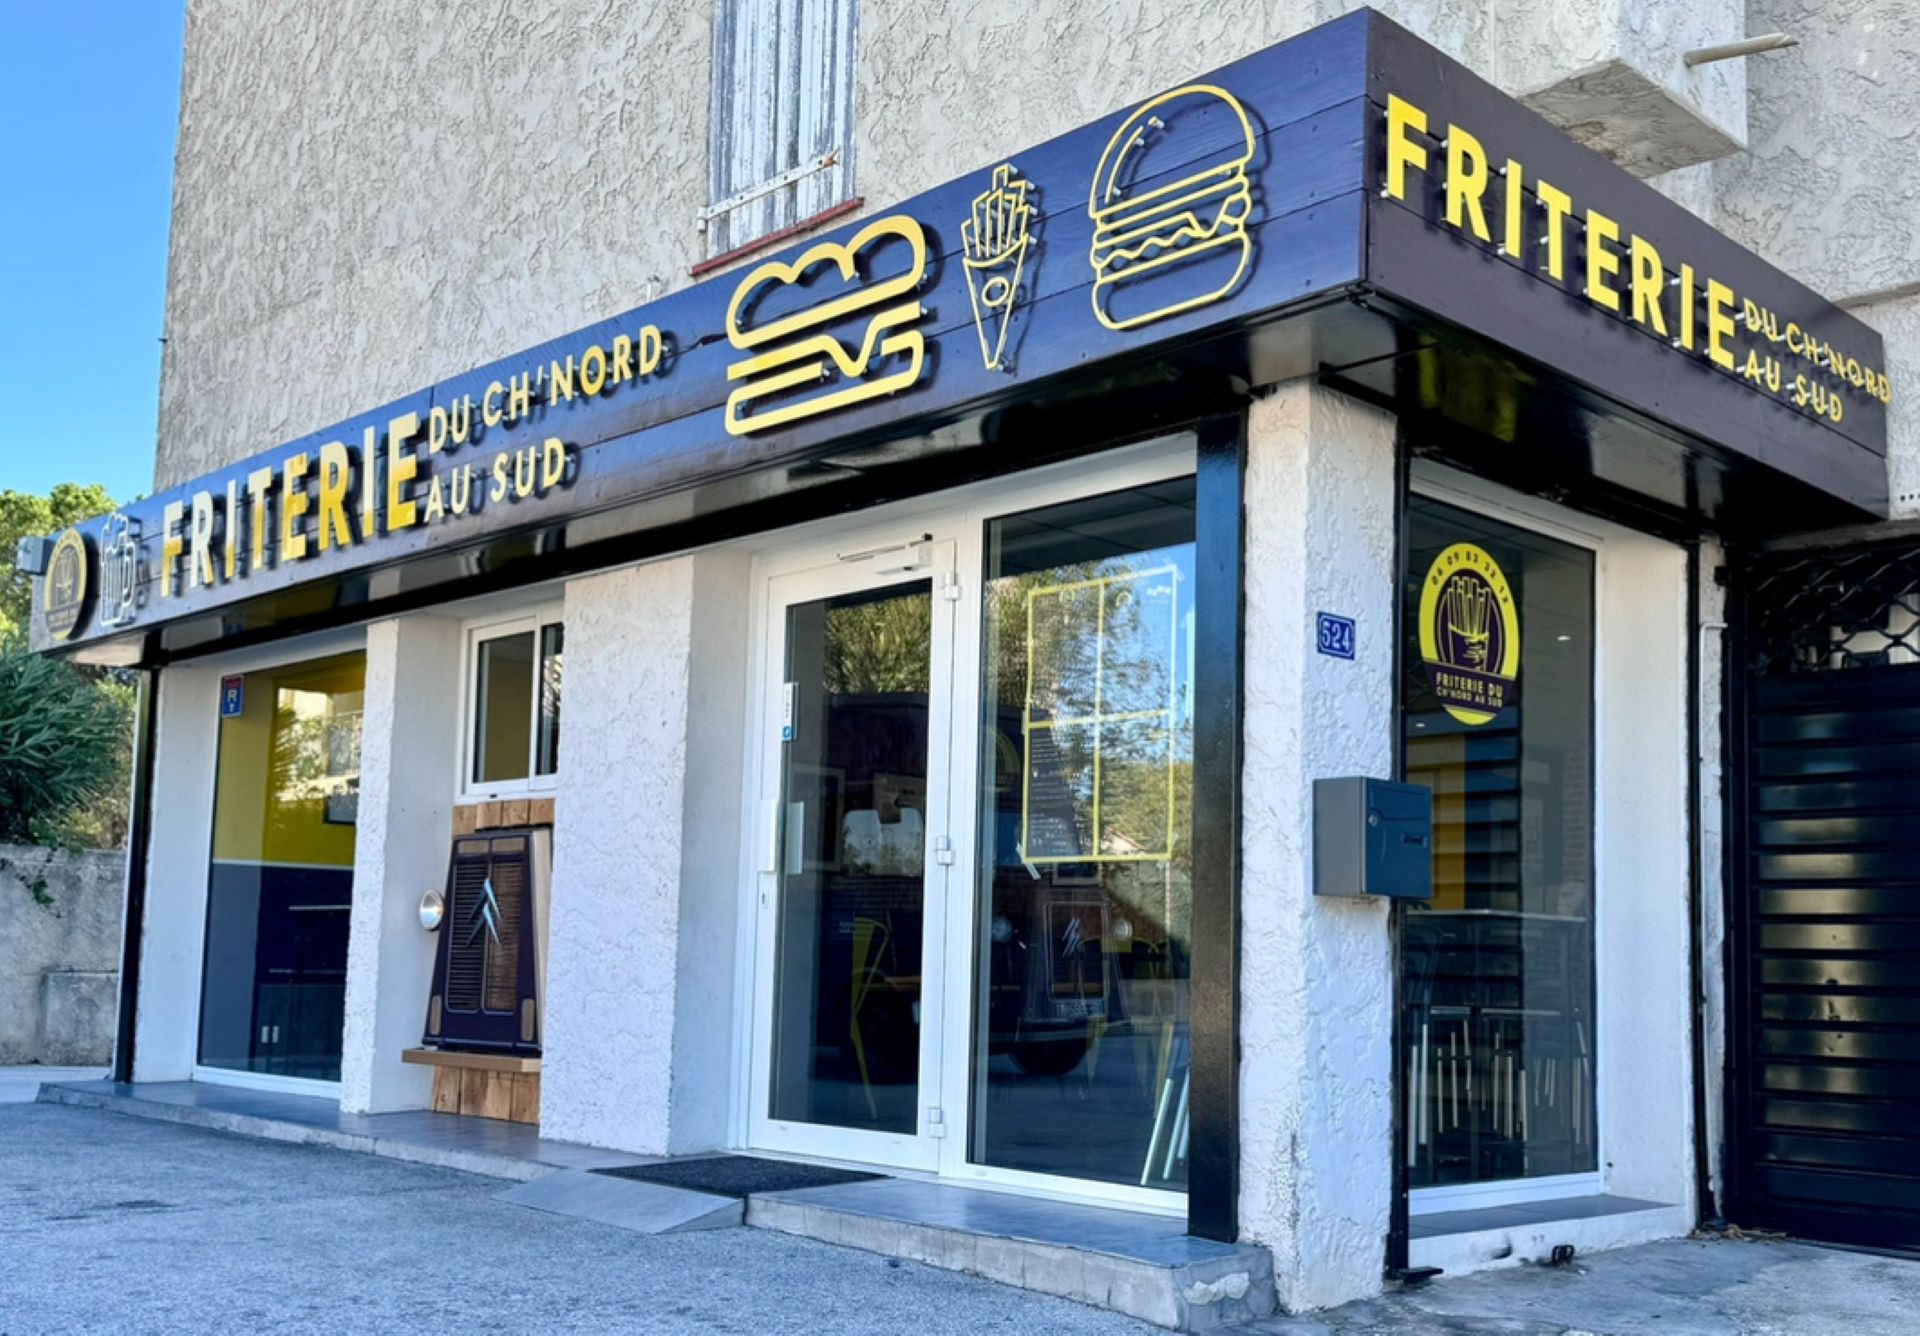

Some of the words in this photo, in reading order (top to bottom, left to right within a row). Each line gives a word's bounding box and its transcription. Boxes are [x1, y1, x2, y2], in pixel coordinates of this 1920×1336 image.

[1387, 93, 1736, 371] FRITERIE
[429, 394, 471, 454] DU
[483, 324, 662, 427] CH'NORD
[1743, 297, 1778, 342] DU
[1786, 322, 1893, 404] CH'NORD
[1744, 349, 1781, 393] AU
[1796, 374, 1843, 423] SUD
[160, 411, 419, 598] FRITERIE
[424, 463, 471, 523] AU
[490, 437, 565, 502] SUD
[1322, 620, 1350, 651] 524
[1436, 671, 1484, 694] FRITERIE
[1488, 682, 1504, 698] DU
